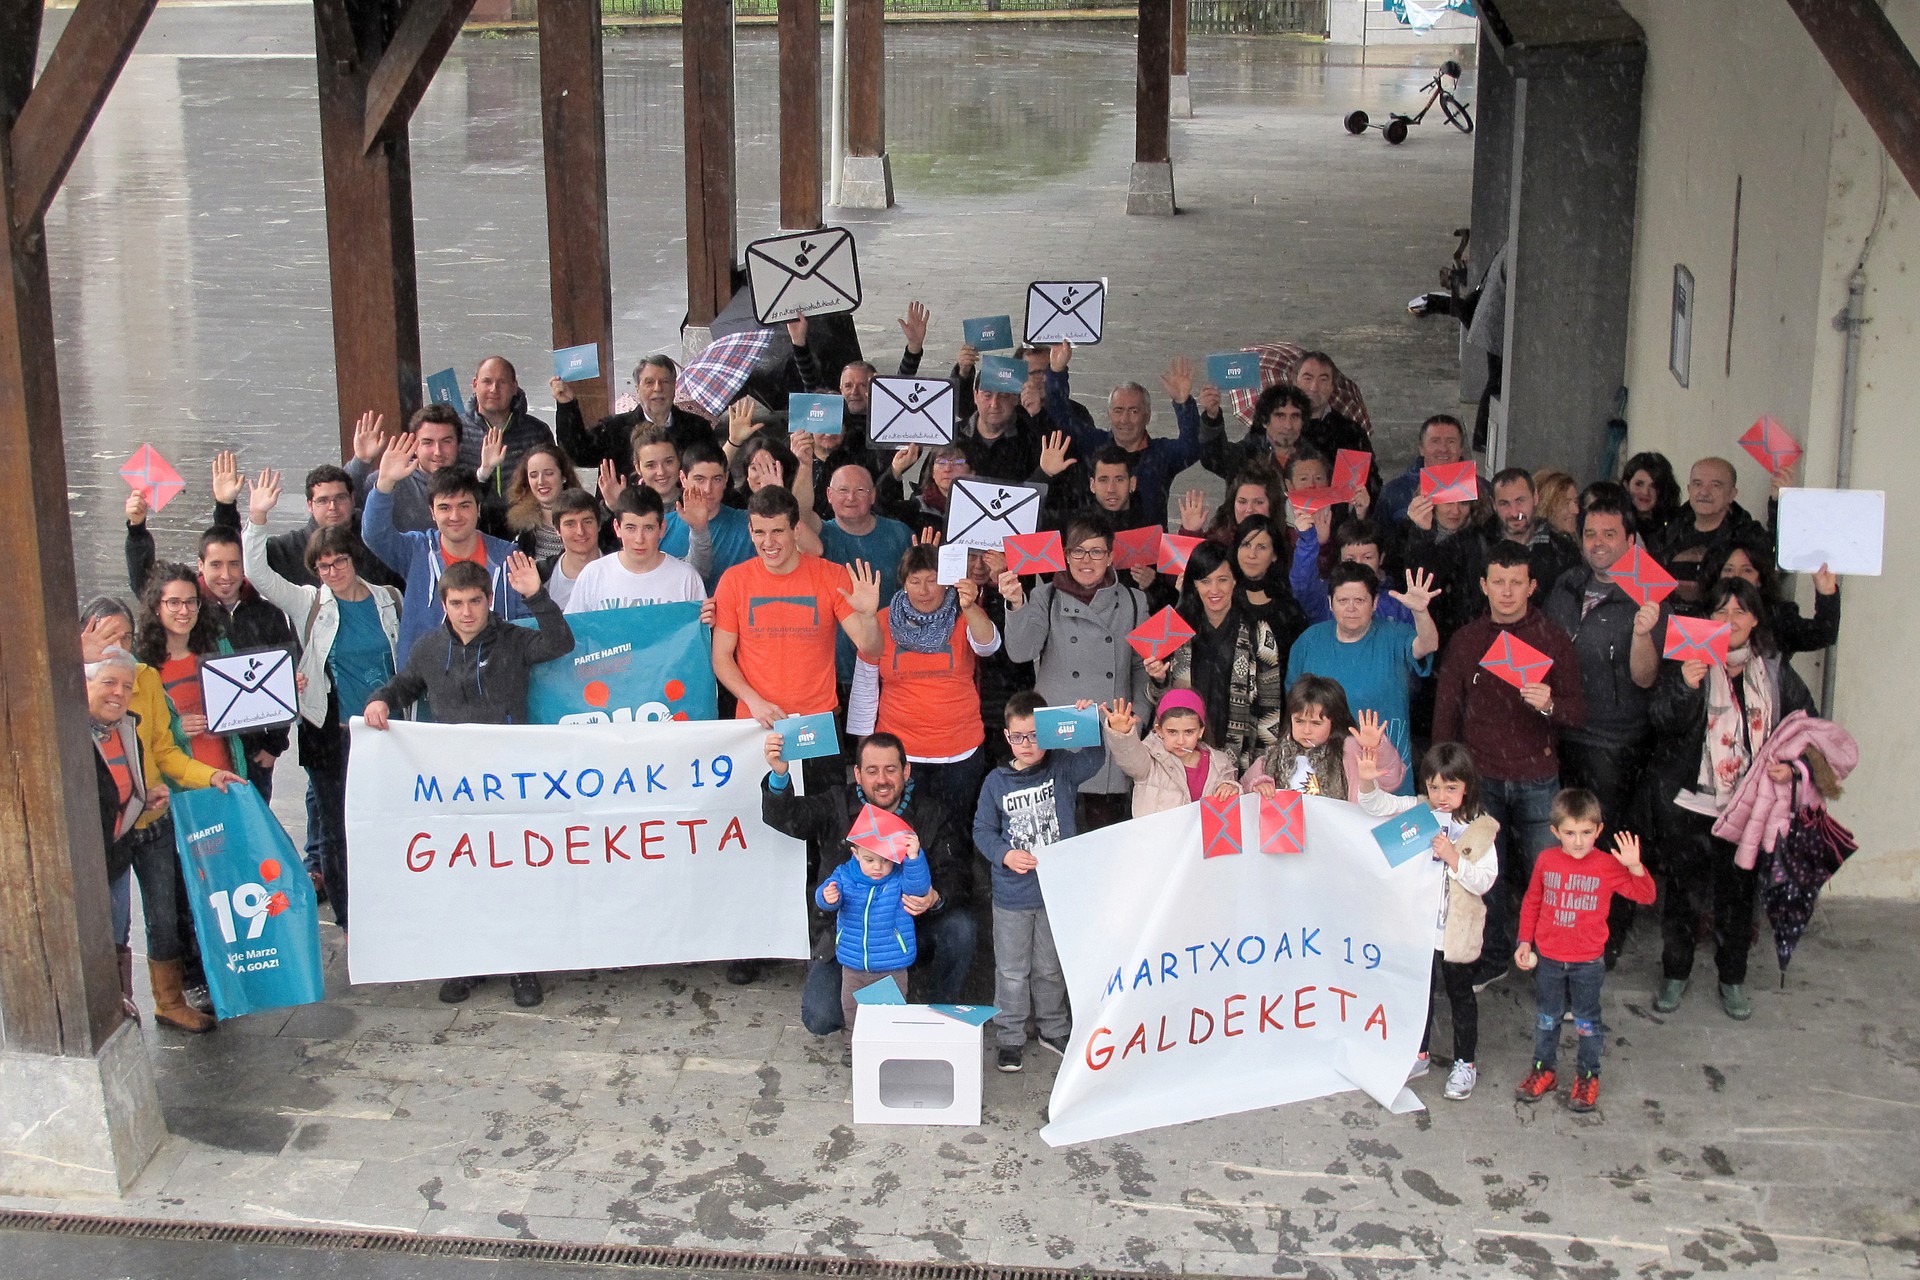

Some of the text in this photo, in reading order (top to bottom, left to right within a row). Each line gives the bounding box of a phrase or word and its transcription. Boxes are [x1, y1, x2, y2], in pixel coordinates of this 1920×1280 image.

[574, 643, 632, 667] PARTE HARTU!
[413, 754, 735, 803] MARTXOAK 19
[1006, 784, 1054, 812] CITY LIFE
[192, 822, 225, 840] HARTU!
[405, 815, 748, 873] GALDEKETA
[209, 882, 271, 944] 19
[246, 947, 278, 959] Marzo
[247, 958, 280, 972] GOAZ!
[1101, 926, 1382, 1002] MARTXOAK 19
[1085, 985, 1389, 1071] GALDEKETA
